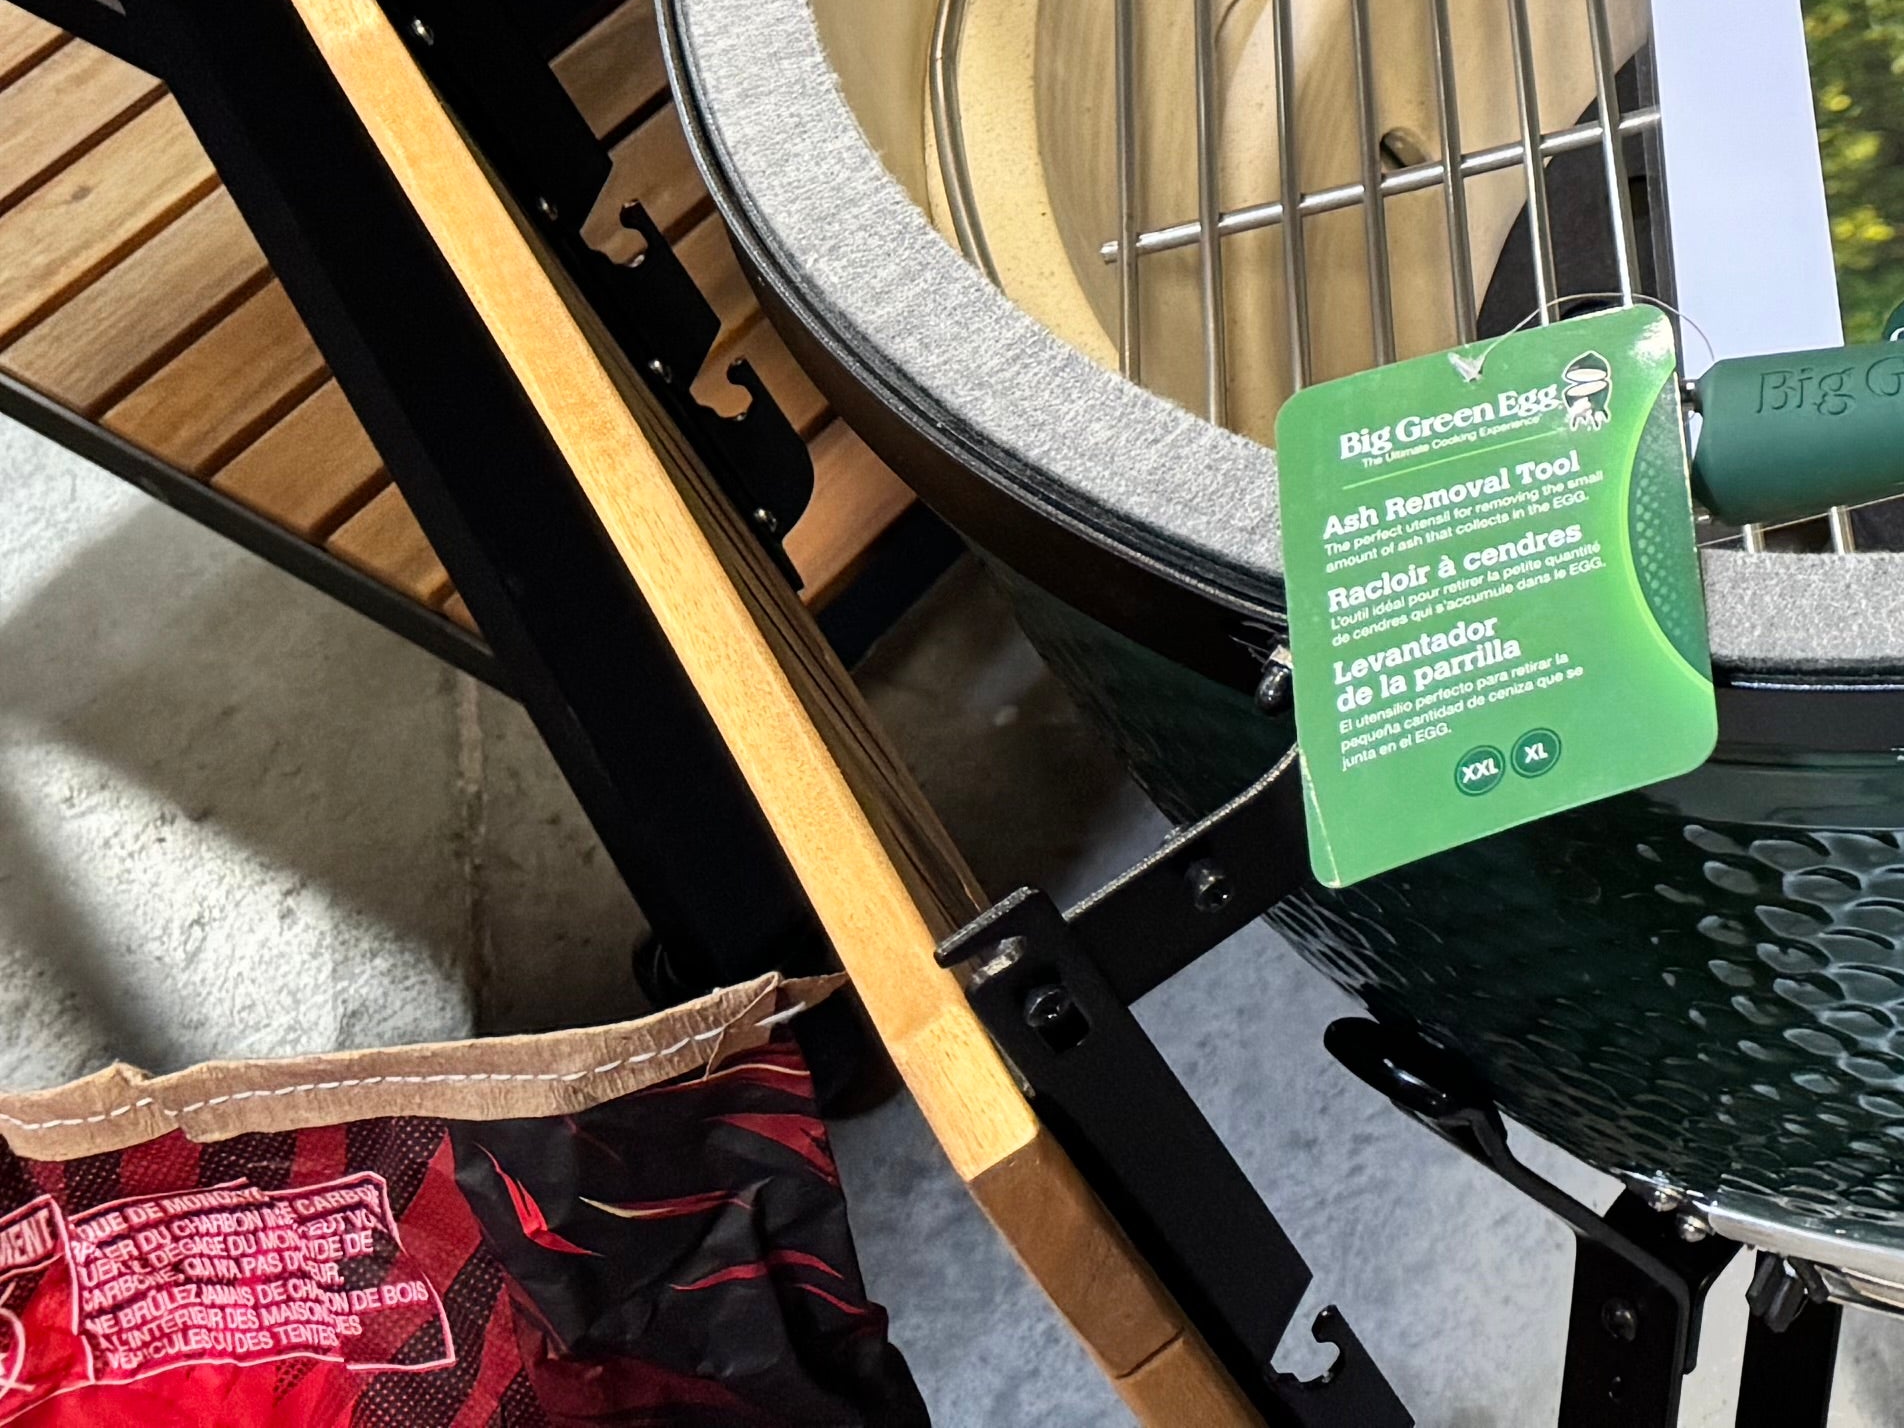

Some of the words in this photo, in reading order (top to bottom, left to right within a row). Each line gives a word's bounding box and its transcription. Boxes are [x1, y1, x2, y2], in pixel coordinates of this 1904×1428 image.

[1339, 427, 1393, 460] Big
[1395, 401, 1495, 443] Green
[1497, 383, 1560, 418] Egg
[1755, 366, 1856, 417] Big
[1323, 505, 1379, 540] Ash
[1385, 467, 1511, 522] Removal
[1515, 449, 1581, 487] Tool
[1324, 541, 1351, 556] The
[1353, 524, 1403, 550] perfect
[1405, 511, 1451, 533] utensil
[1453, 504, 1473, 520] for
[1475, 488, 1539, 515] removing
[1541, 478, 1565, 496] the
[1567, 469, 1604, 490] small
[1328, 564, 1431, 613] Racloir
[1437, 554, 1457, 579] à
[1463, 524, 1583, 572] cendres
[1333, 617, 1498, 685] Levantador
[1336, 685, 1373, 713] de
[1380, 674, 1408, 699] la
[1413, 638, 1522, 692] parrilla
[1461, 757, 1499, 784] XXL
[1524, 742, 1549, 764] XL
[240, 1251, 284, 1279] PAS
[351, 1287, 382, 1312] DE
[380, 1280, 430, 1306] BOIS
[234, 1330, 275, 1354] DES
[273, 1322, 341, 1348] TENTES
